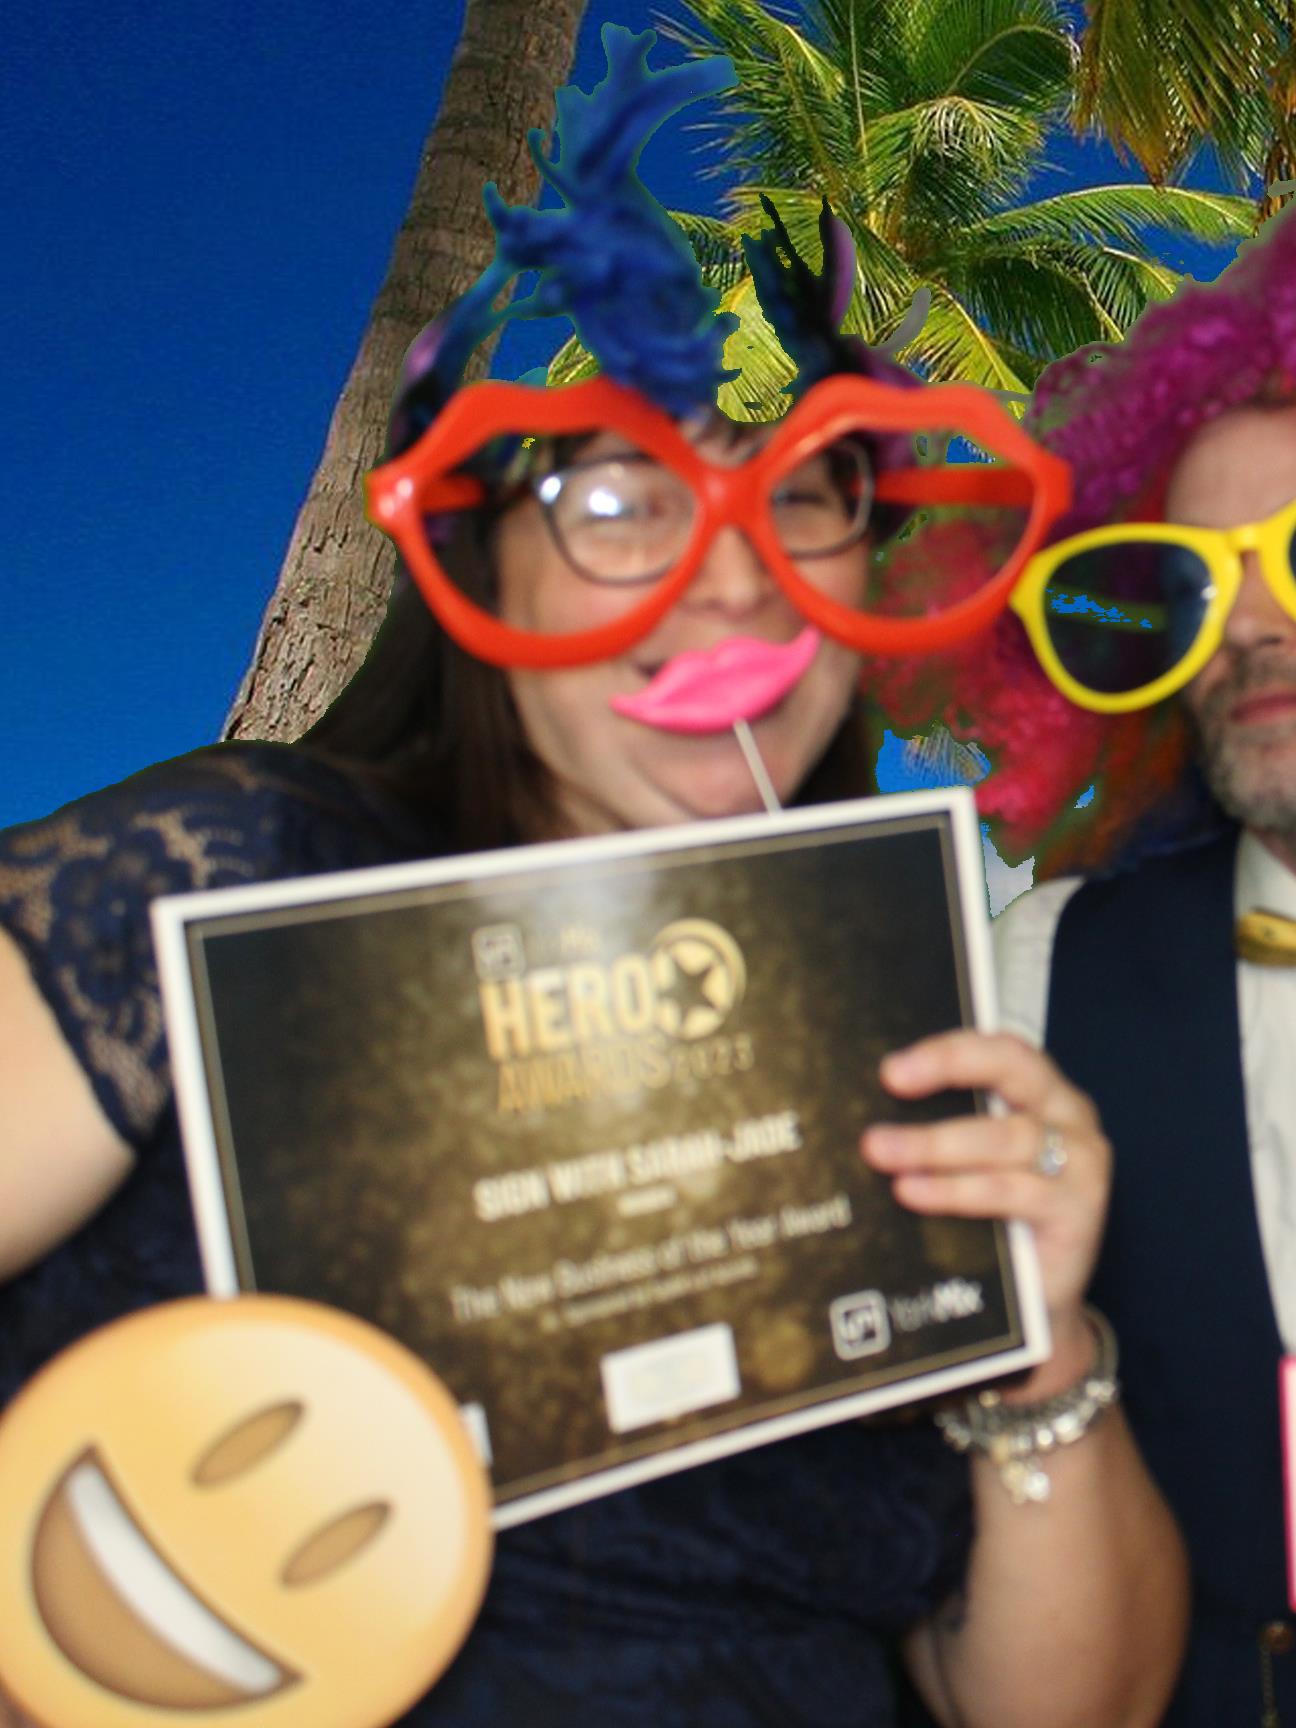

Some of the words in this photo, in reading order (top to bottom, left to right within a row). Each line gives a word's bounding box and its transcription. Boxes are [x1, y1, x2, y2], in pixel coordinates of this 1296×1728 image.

[479, 952, 655, 1060] HERO
[498, 1035, 672, 1114] AWARDS
[473, 1169, 552, 1222] SIGN
[549, 1150, 628, 1203] WITH
[779, 1192, 854, 1241] Award
